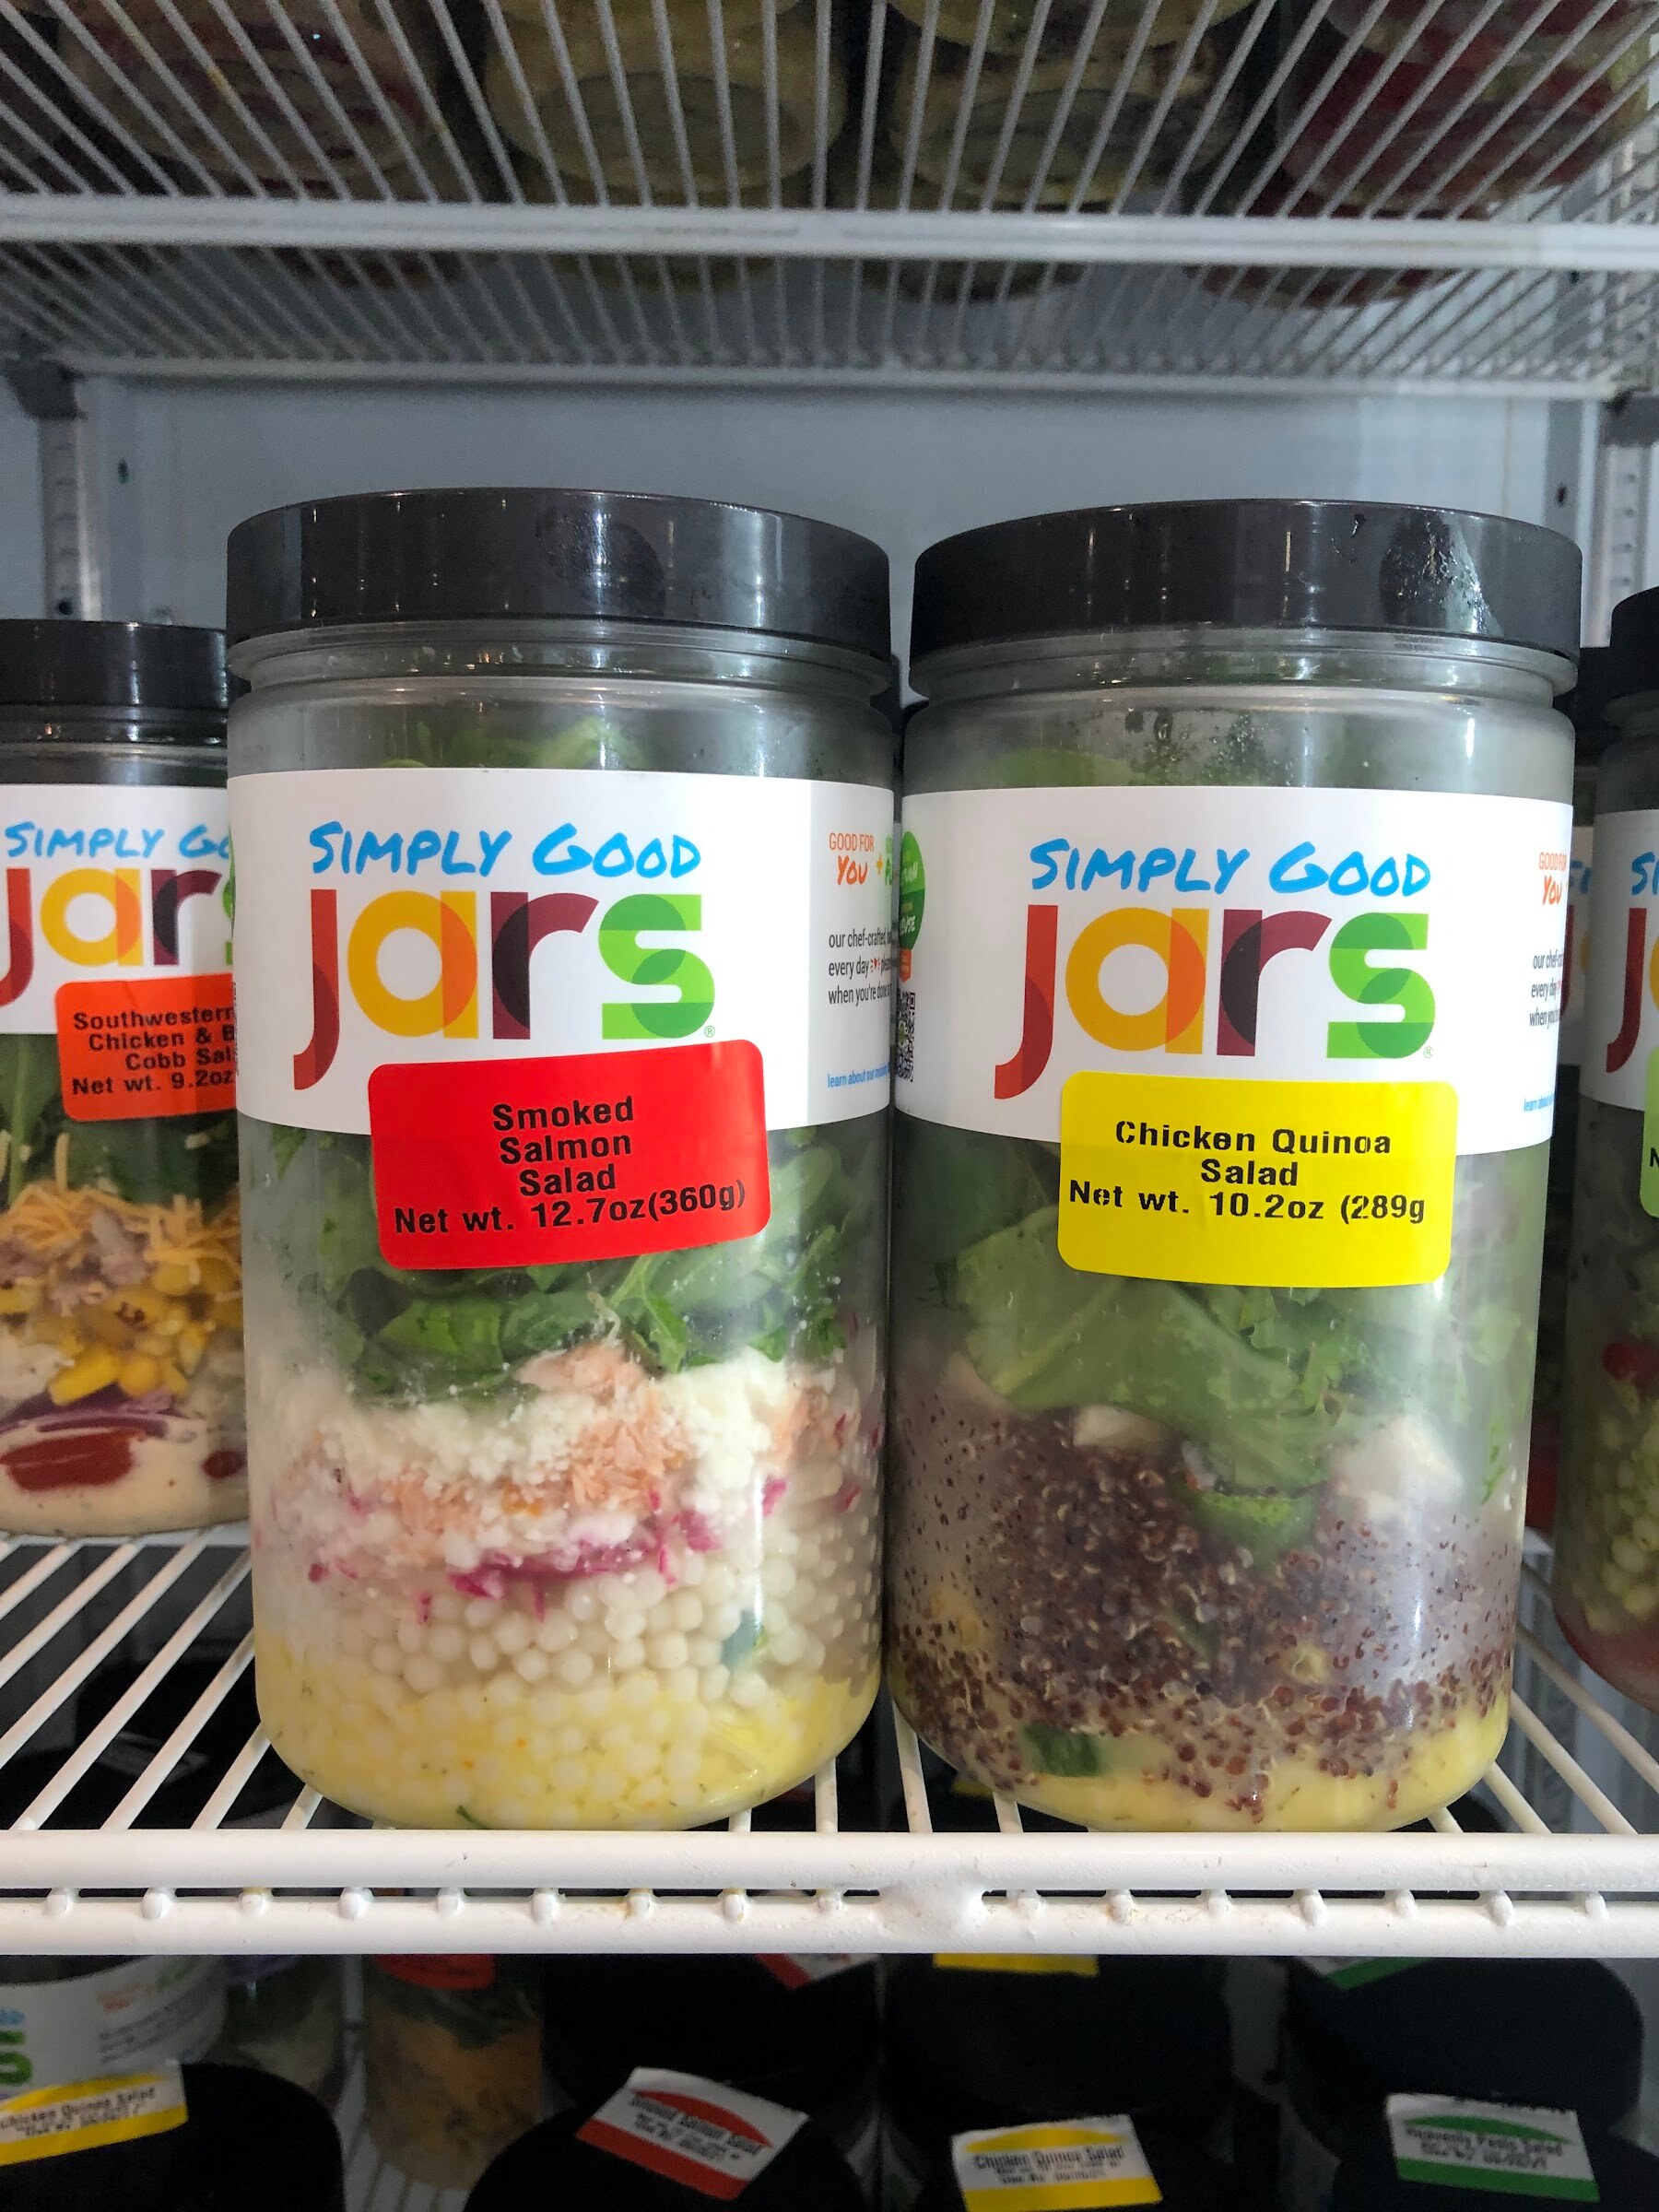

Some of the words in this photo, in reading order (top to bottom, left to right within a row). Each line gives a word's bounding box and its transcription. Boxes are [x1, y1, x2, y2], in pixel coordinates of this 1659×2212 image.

[5, 821, 164, 858] SIMPLY
[310, 821, 512, 877] SIMPLY
[533, 823, 701, 877] GOOD
[829, 832, 857, 851] GOOD
[859, 833, 874, 853] FOR
[837, 855, 868, 885] YOU
[1030, 839, 1250, 894] SIMPLY
[1269, 841, 1431, 896] GOOD
[1539, 853, 1558, 870] GOOD
[1543, 876, 1562, 905] YOU
[829, 933, 846, 947] our
[829, 960, 854, 980] every
[856, 956, 870, 978] day
[1533, 955, 1545, 969] our
[294, 889, 715, 1089] jars
[829, 985, 853, 1004] when
[856, 982, 877, 1006] you're
[994, 904, 1436, 1099] jars
[1531, 982, 1548, 1001] every
[74, 1006, 234, 1030] Southwestern
[1529, 1007, 1547, 1027] when
[89, 1031, 184, 1052] Chicken
[195, 1027, 211, 1044] &
[125, 1052, 186, 1071] Cobb
[72, 1077, 113, 1095] Net
[124, 1075, 160, 1091] wt.
[171, 1069, 234, 1089] 9.2oz
[828, 1075, 846, 1088] learn
[848, 1070, 865, 1084] about
[493, 1096, 634, 1131] Smoked
[500, 1134, 631, 1164] Salmon
[1115, 1120, 1255, 1151] Chicken
[1272, 1128, 1392, 1155] Quinoa
[519, 1164, 616, 1196] Salad
[1200, 1159, 1299, 1186] Salad
[395, 1207, 449, 1233] Net
[466, 1208, 513, 1231] wt.
[531, 1179, 746, 1228] 12.7oz(360g)
[1069, 1180, 1123, 1208] Net
[1138, 1190, 1189, 1214] wt.
[1211, 1192, 1324, 1220] 10.2oz
[1340, 1194, 1426, 1224] (289g
